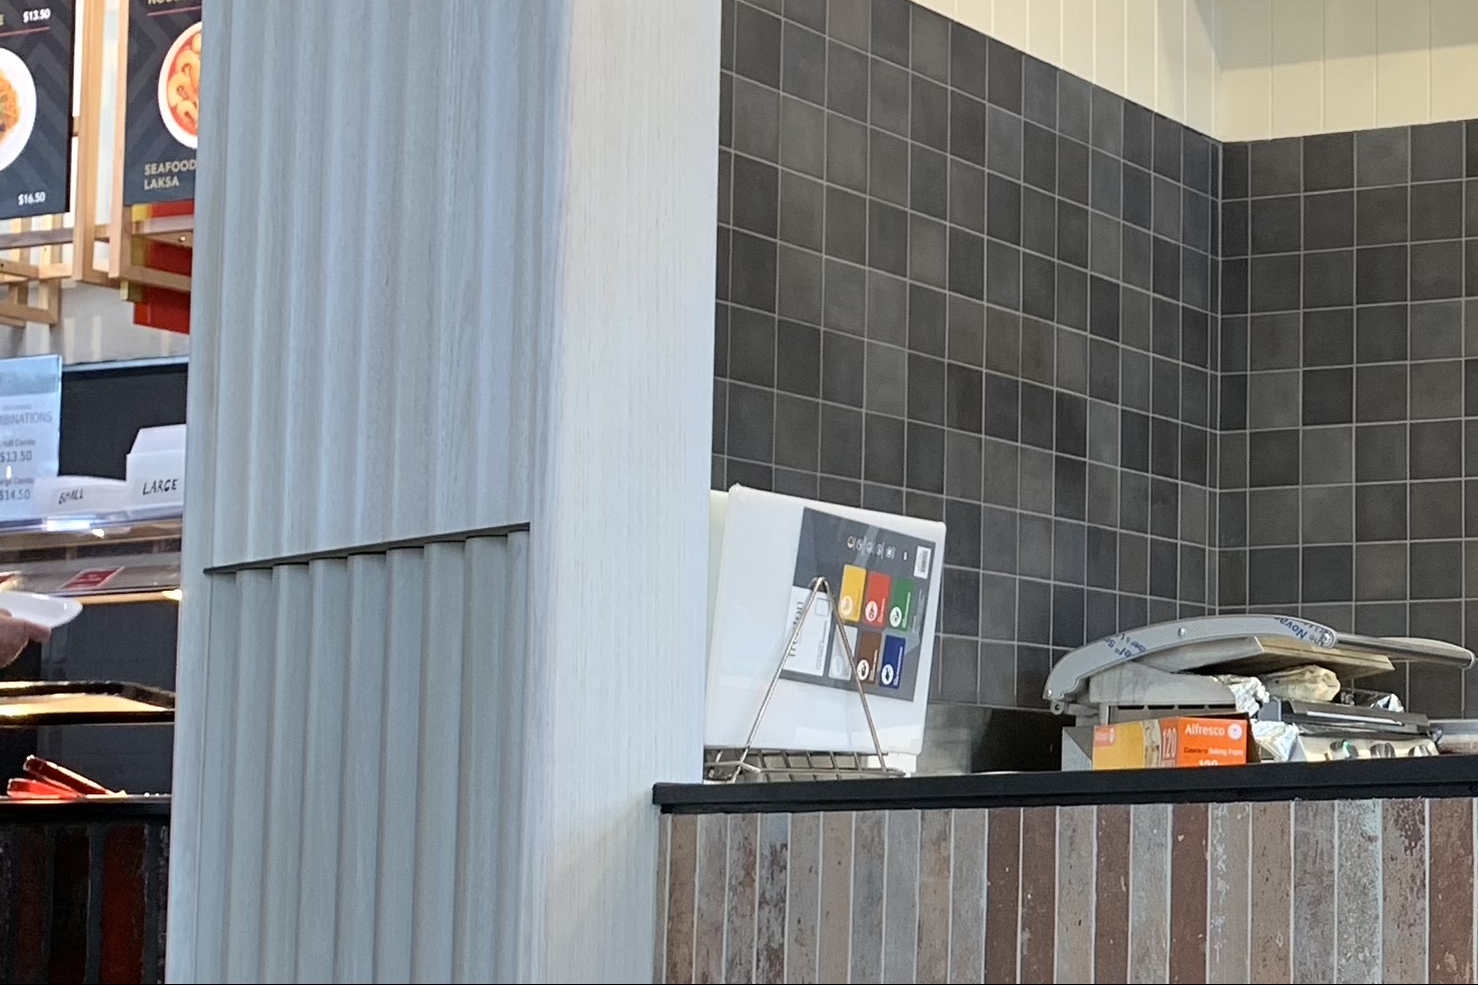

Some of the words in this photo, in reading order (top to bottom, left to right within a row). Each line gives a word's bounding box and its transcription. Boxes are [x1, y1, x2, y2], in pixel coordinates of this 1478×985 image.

[23, 8, 51, 23] $13.50
[144, 159, 196, 176] SEAFOOD
[144, 176, 180, 190] LAKSA
[18, 192, 46, 206] $16.50
[142, 479, 179, 495] LARGE
[1185, 724, 1226, 736] Alfresco
[1162, 728, 1178, 759] 120
